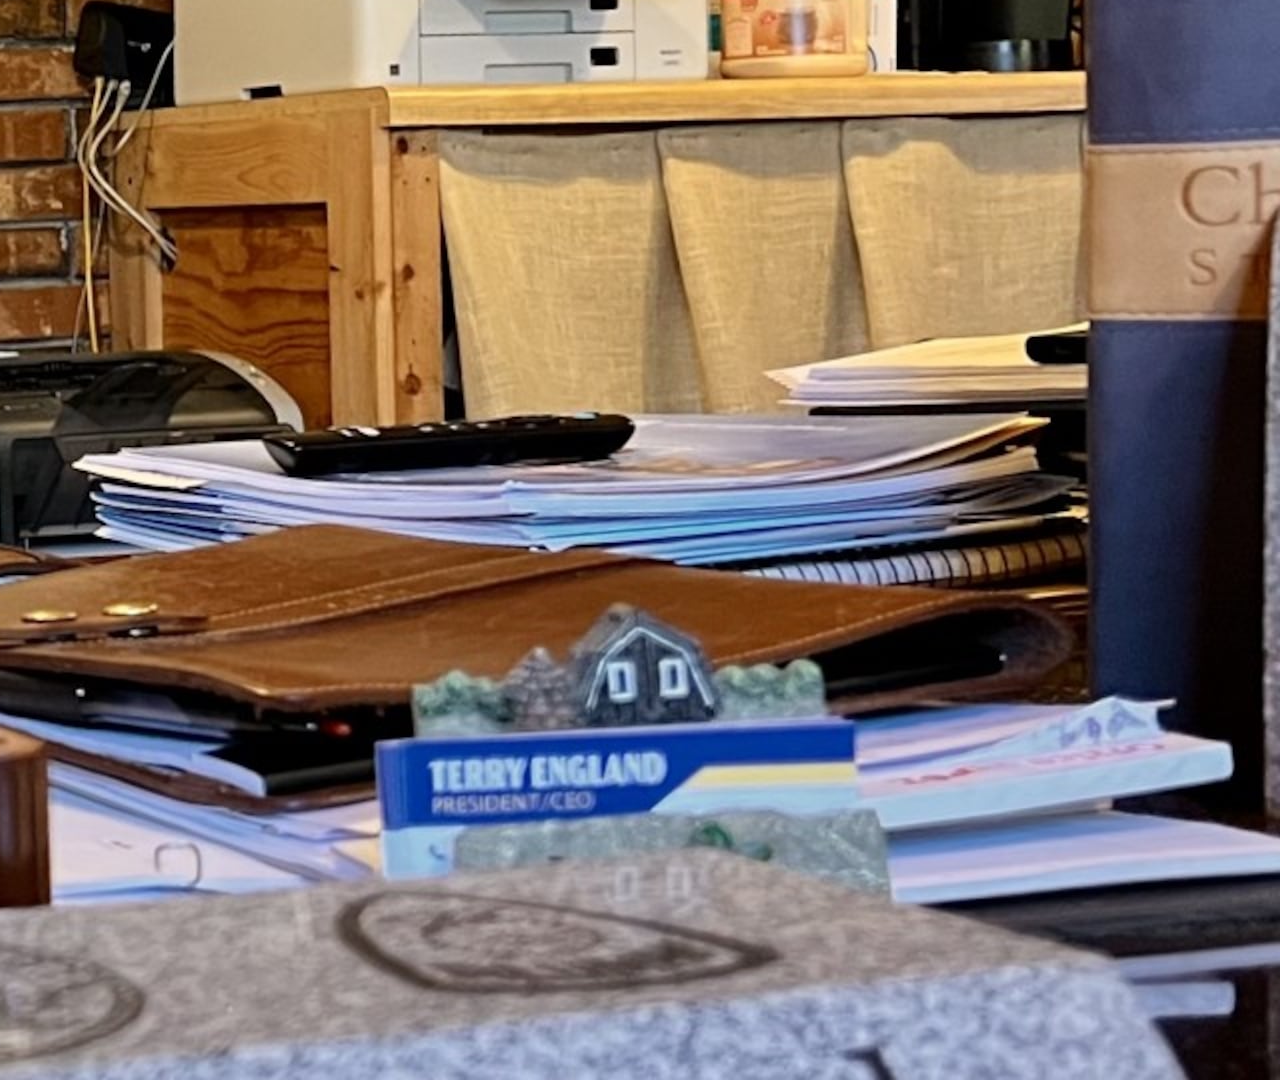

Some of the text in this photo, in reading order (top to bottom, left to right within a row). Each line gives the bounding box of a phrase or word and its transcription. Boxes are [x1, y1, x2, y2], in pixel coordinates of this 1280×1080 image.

[428, 750, 669, 794] TERRY ENGLAND
[430, 791, 597, 815] PRESIDENT/CEO
